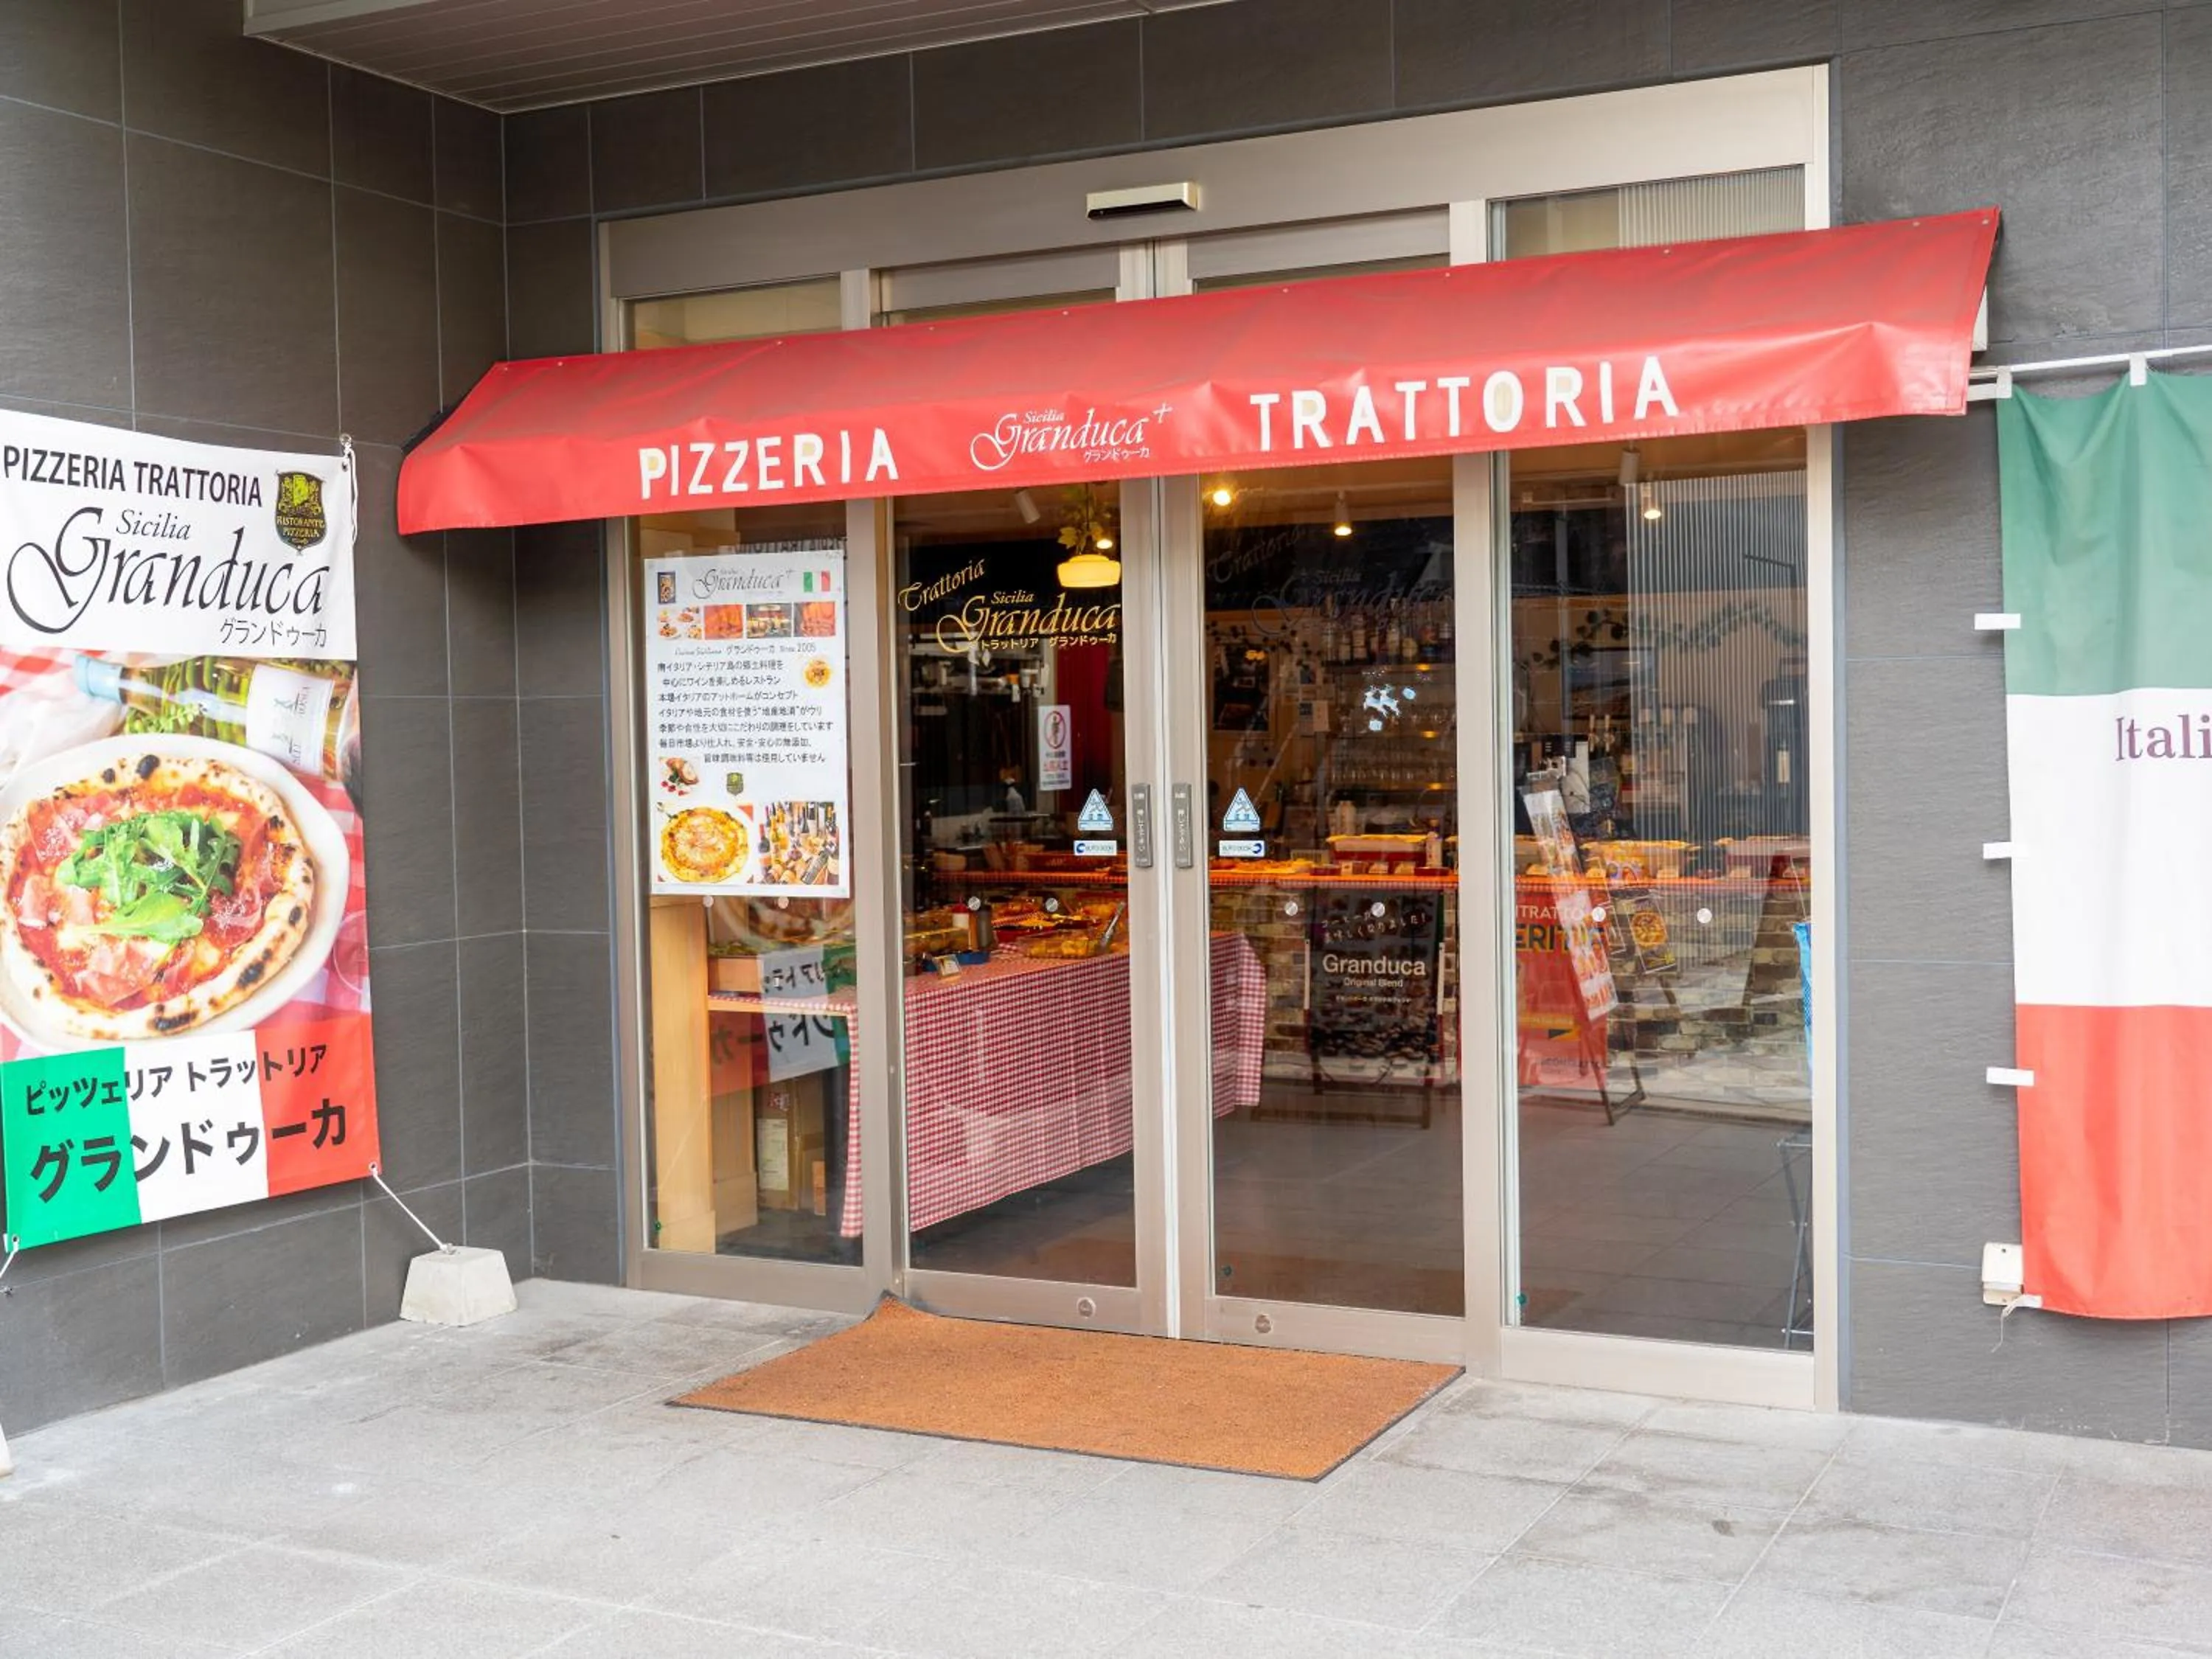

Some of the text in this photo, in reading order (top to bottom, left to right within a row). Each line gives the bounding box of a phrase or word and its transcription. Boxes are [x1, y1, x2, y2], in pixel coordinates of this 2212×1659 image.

[1023, 408, 1064, 424] Sicilia
[1250, 356, 1679, 452] TRATTORIA
[3, 445, 262, 507] PIZZERIA TRATTORIA
[639, 428, 899, 500] PIZZERIA
[116, 509, 191, 540] Sicilia
[276, 515, 325, 528] RISTORANTE
[7, 507, 330, 634] Granduca
[897, 559, 985, 611] Trattoria
[936, 592, 1121, 653] Granduca
[990, 590, 1034, 605] Sicilia
[220, 618, 327, 649] グランドゥーカ
[981, 633, 1117, 650] トラットリア グランドゥーカ
[1322, 953, 1427, 976] Granduca
[25, 1043, 327, 1116] ピッツェリア トラットリア
[30, 1098, 347, 1203] グランドゥーカ
